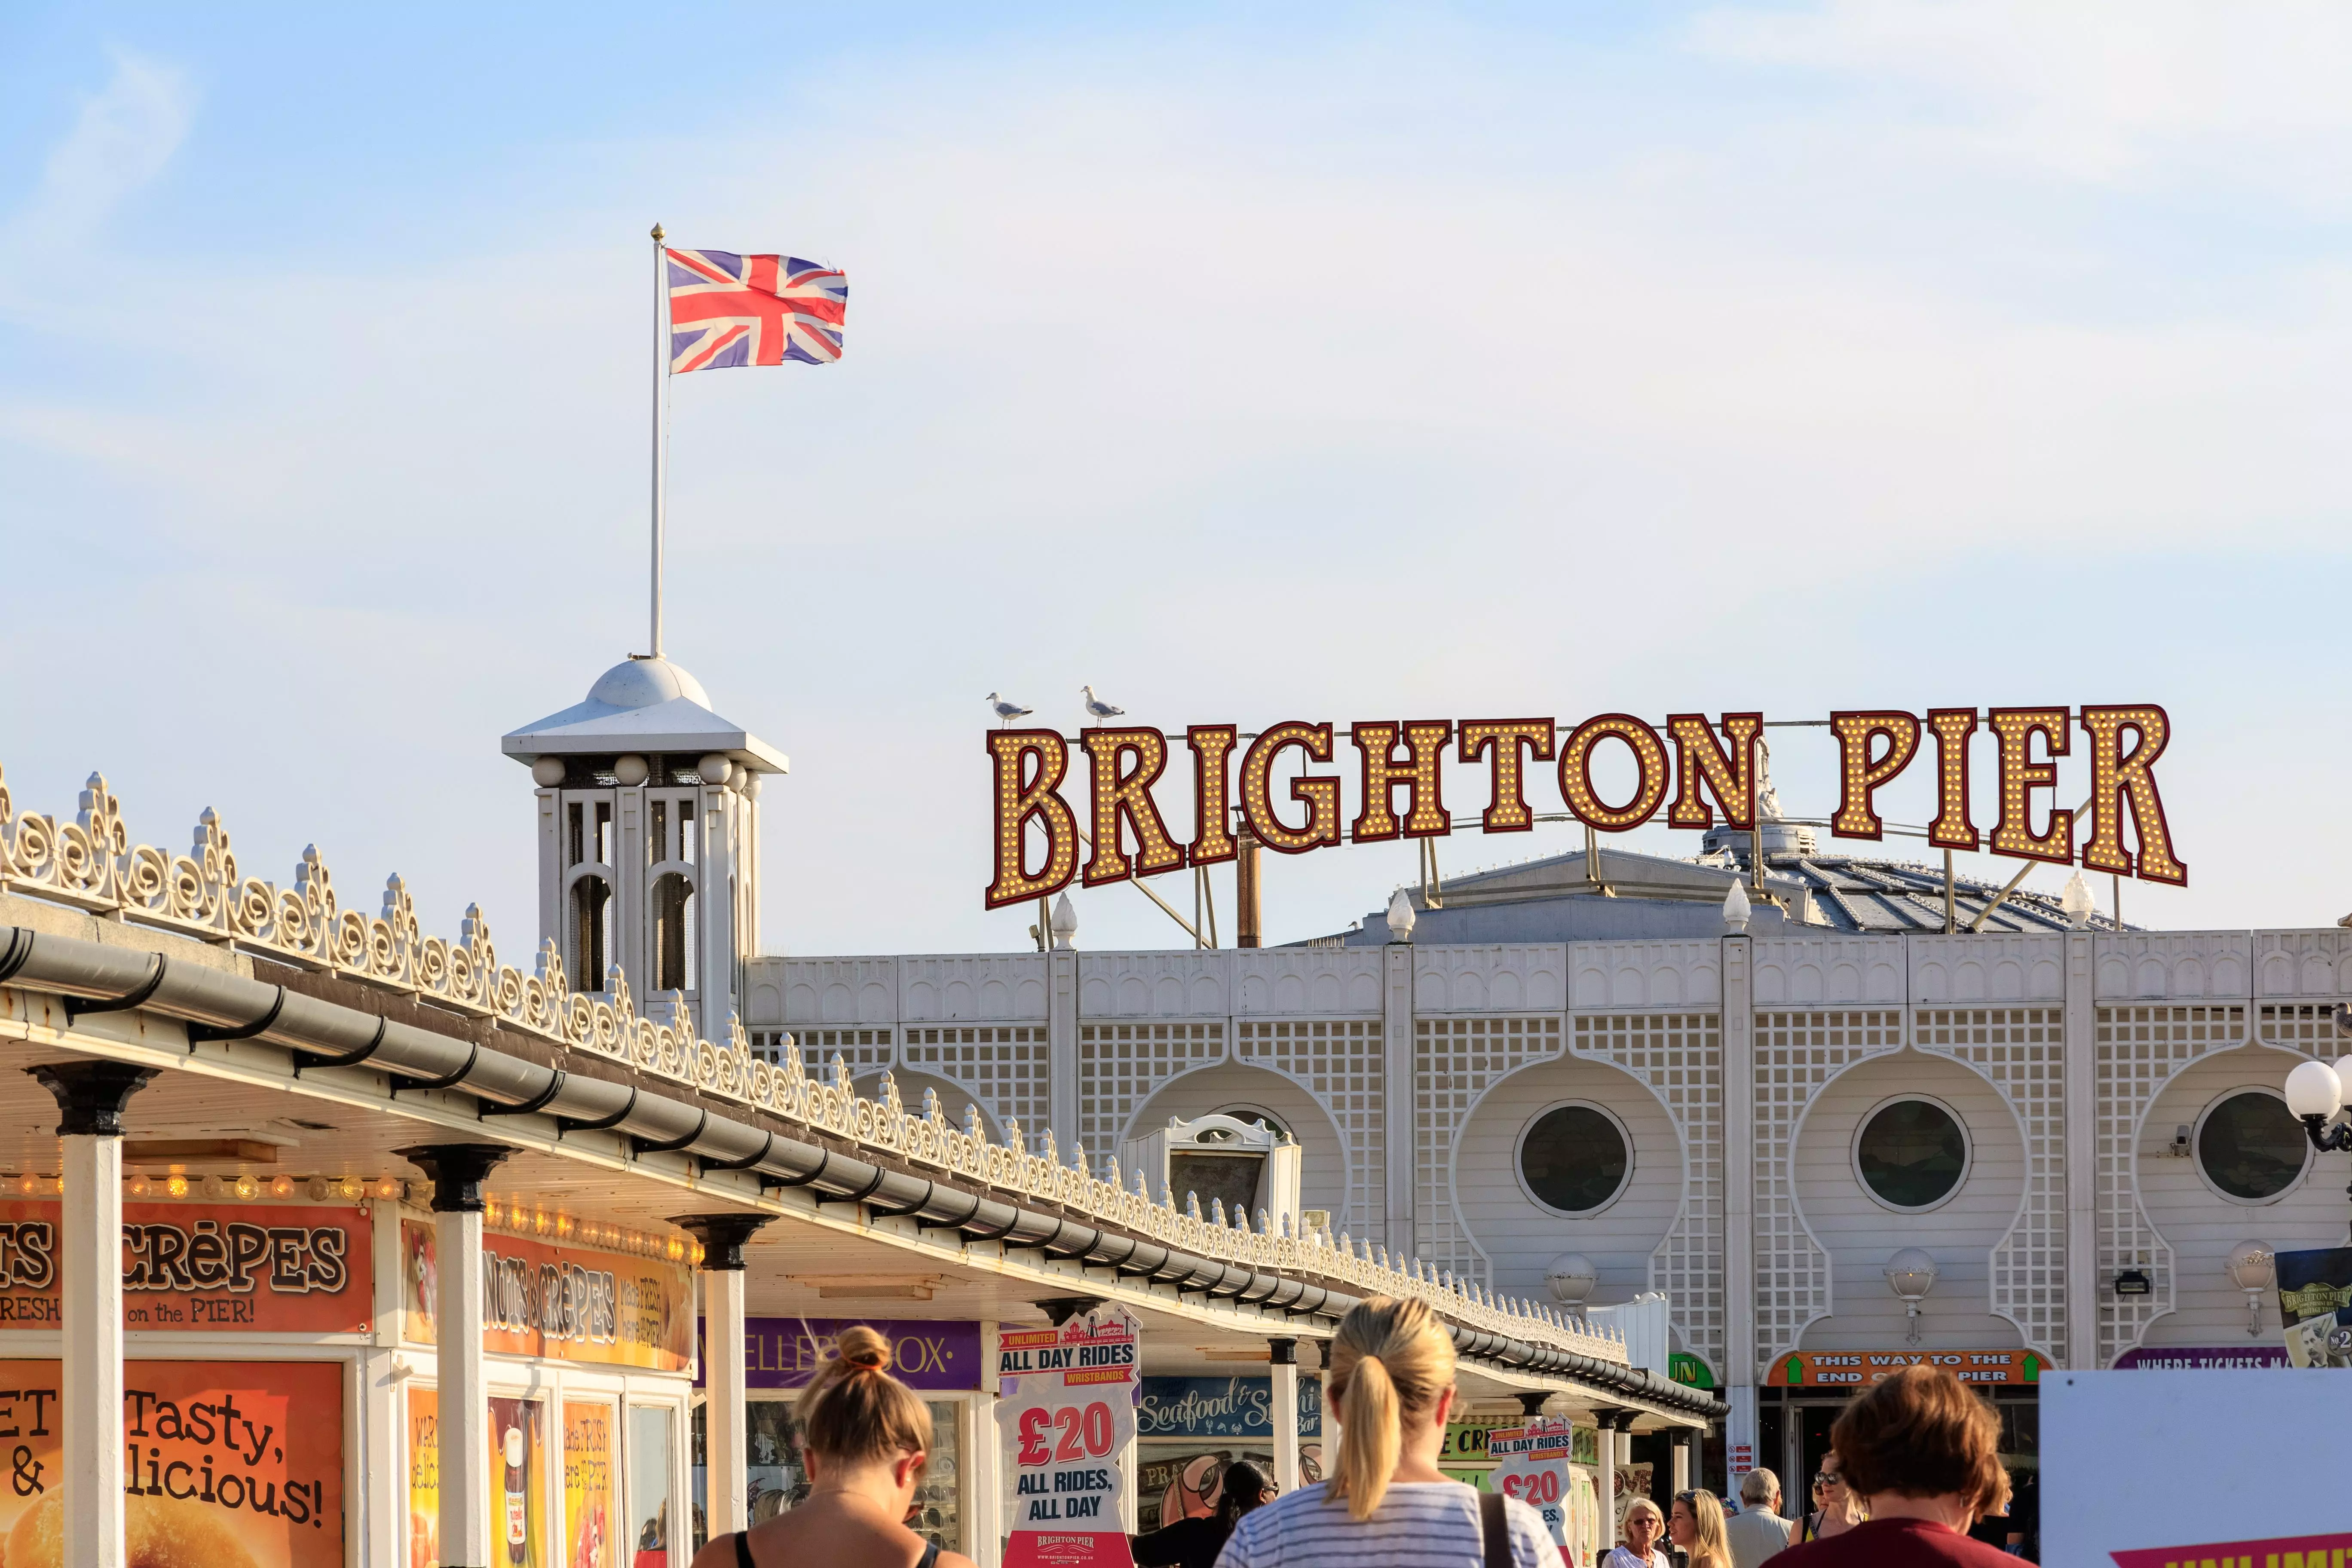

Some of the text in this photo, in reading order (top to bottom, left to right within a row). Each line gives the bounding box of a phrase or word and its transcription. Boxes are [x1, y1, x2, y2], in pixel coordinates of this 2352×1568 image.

[986, 704, 2187, 910] BRIGHTON PIER
[482, 1250, 530, 1334] NUTS
[530, 1268, 538, 1327] &
[620, 1276, 661, 1313] Made FRESH
[2286, 1291, 2347, 1308] BRIGHTON PIER
[128, 1308, 149, 1322] on
[155, 1303, 183, 1322] the
[191, 1298, 254, 1323] PIER!
[621, 1309, 640, 1344] here
[1009, 1333, 1056, 1345] UNLIMITED
[2340, 1331, 2352, 1348] 2
[884, 1335, 947, 1373] OX
[1000, 1344, 1133, 1372] ALL DAY RIDES
[1812, 1354, 2012, 1366] THIS WAY TO THE
[2137, 1358, 2192, 1370] WHERE
[2199, 1357, 2262, 1370] TICKETS
[1067, 1370, 1124, 1384] WRISTBANDS
[1817, 1372, 1863, 1383] END
[1958, 1371, 2008, 1381] PIER
[1137, 1377, 1239, 1432] Seafood
[1238, 1385, 1251, 1406] &
[124, 1390, 283, 1466] Tasty,
[564, 1418, 579, 1452] ade
[1018, 1402, 1114, 1467] £20
[1495, 1430, 1523, 1439] UNLIMITED
[1491, 1442, 1510, 1454] ALL
[1513, 1439, 1534, 1452] DAY
[1537, 1435, 1569, 1449] RIDES
[1530, 1451, 1564, 1460] WRISTBANDS
[412, 1452, 438, 1489] delic
[565, 1465, 580, 1488] ere
[1017, 1469, 1113, 1495] ALL RIDES,
[12, 1444, 322, 1529] & licious!
[1503, 1470, 1559, 1507] £20
[1028, 1496, 1102, 1521] ALL DAY
[1037, 1536, 1094, 1549] BRIGHTON PIER
